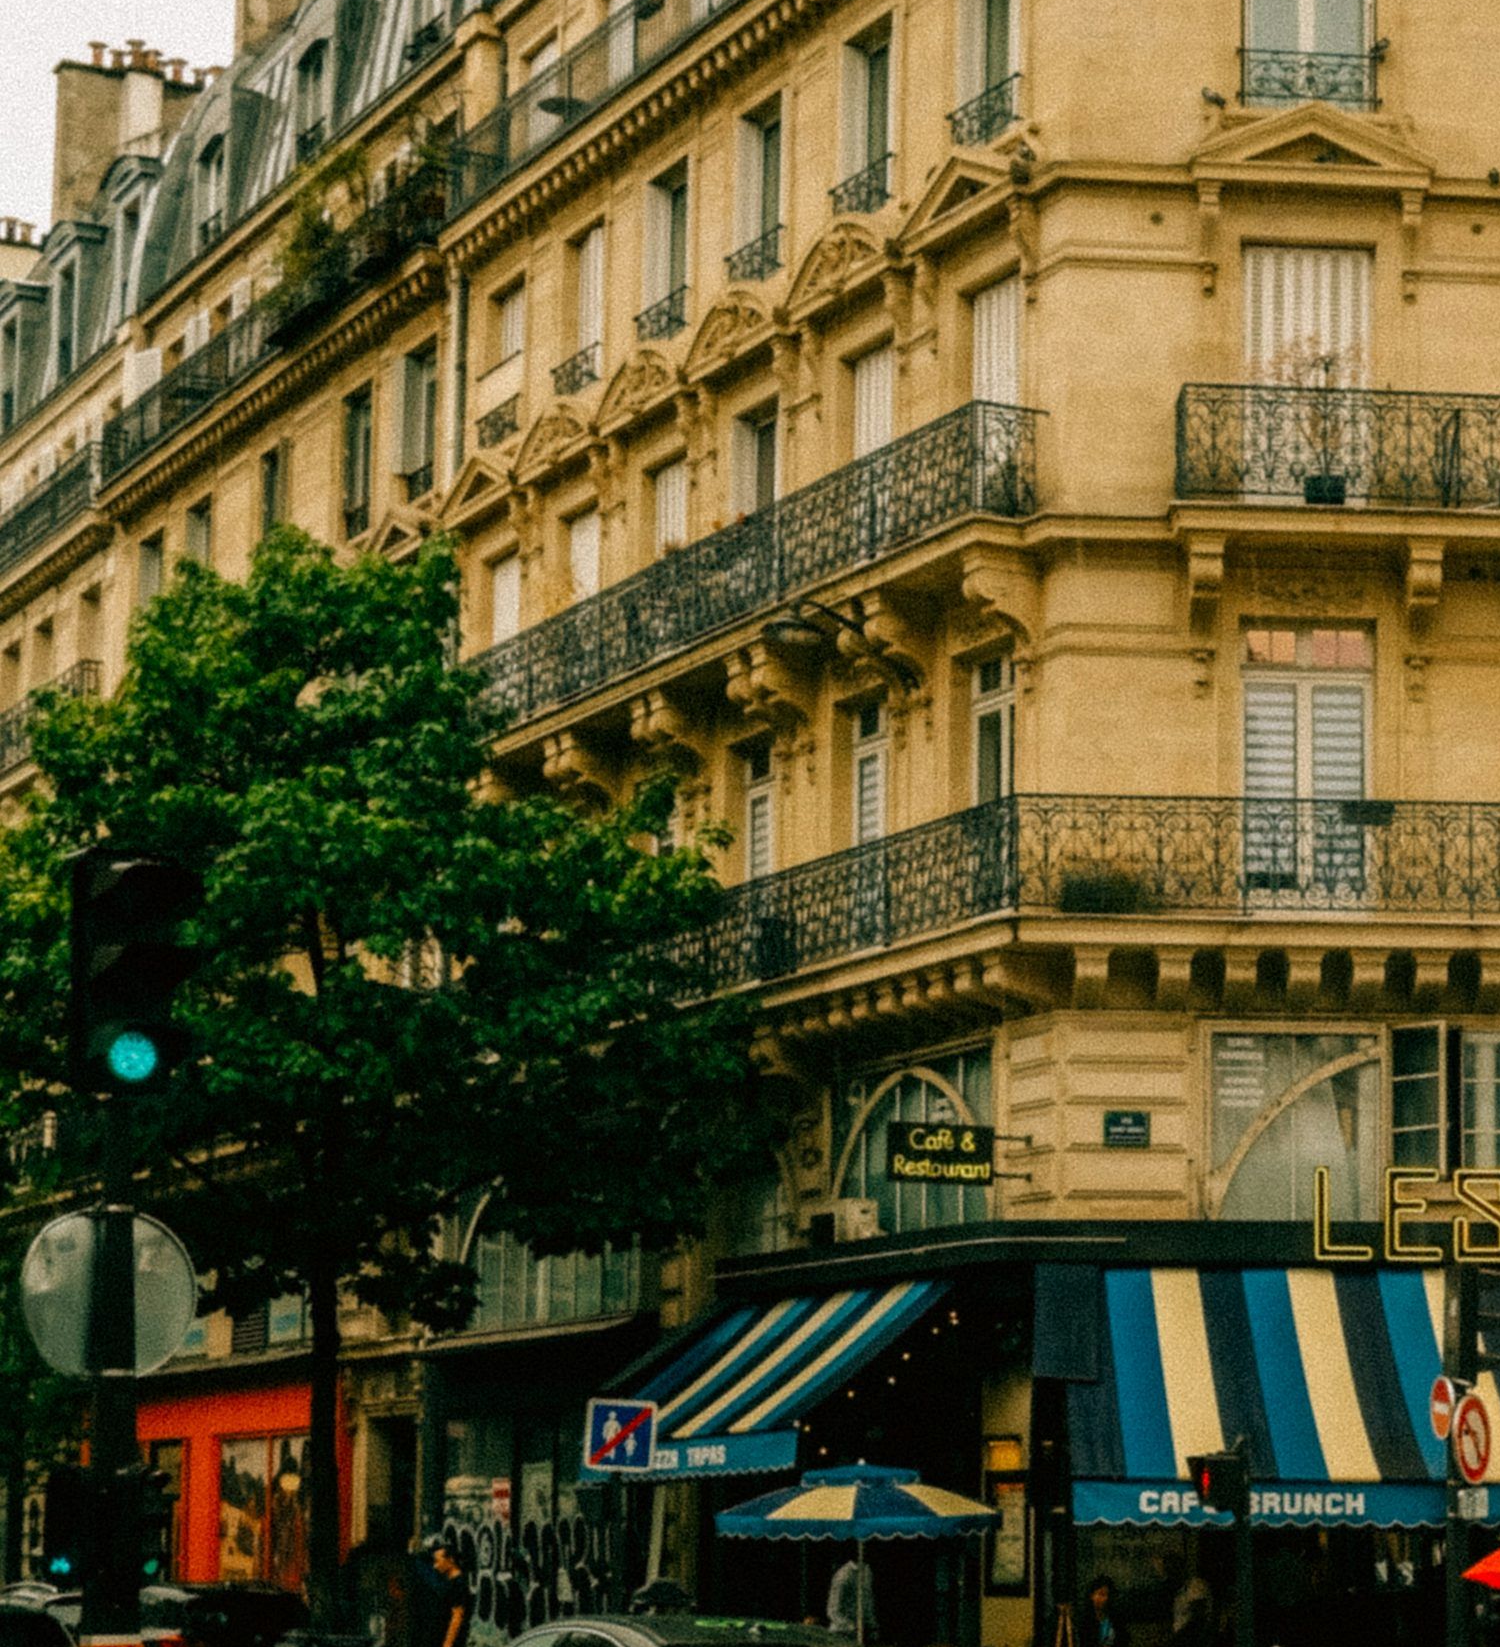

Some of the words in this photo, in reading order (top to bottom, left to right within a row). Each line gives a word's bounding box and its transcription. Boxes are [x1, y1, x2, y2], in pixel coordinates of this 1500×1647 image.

[909, 1127, 955, 1151] Café
[959, 1130, 975, 1152] &
[893, 1154, 991, 1179] Restaurant
[1138, 1490, 1216, 1515] CAF
[1250, 1491, 1365, 1516] BRUNCH
